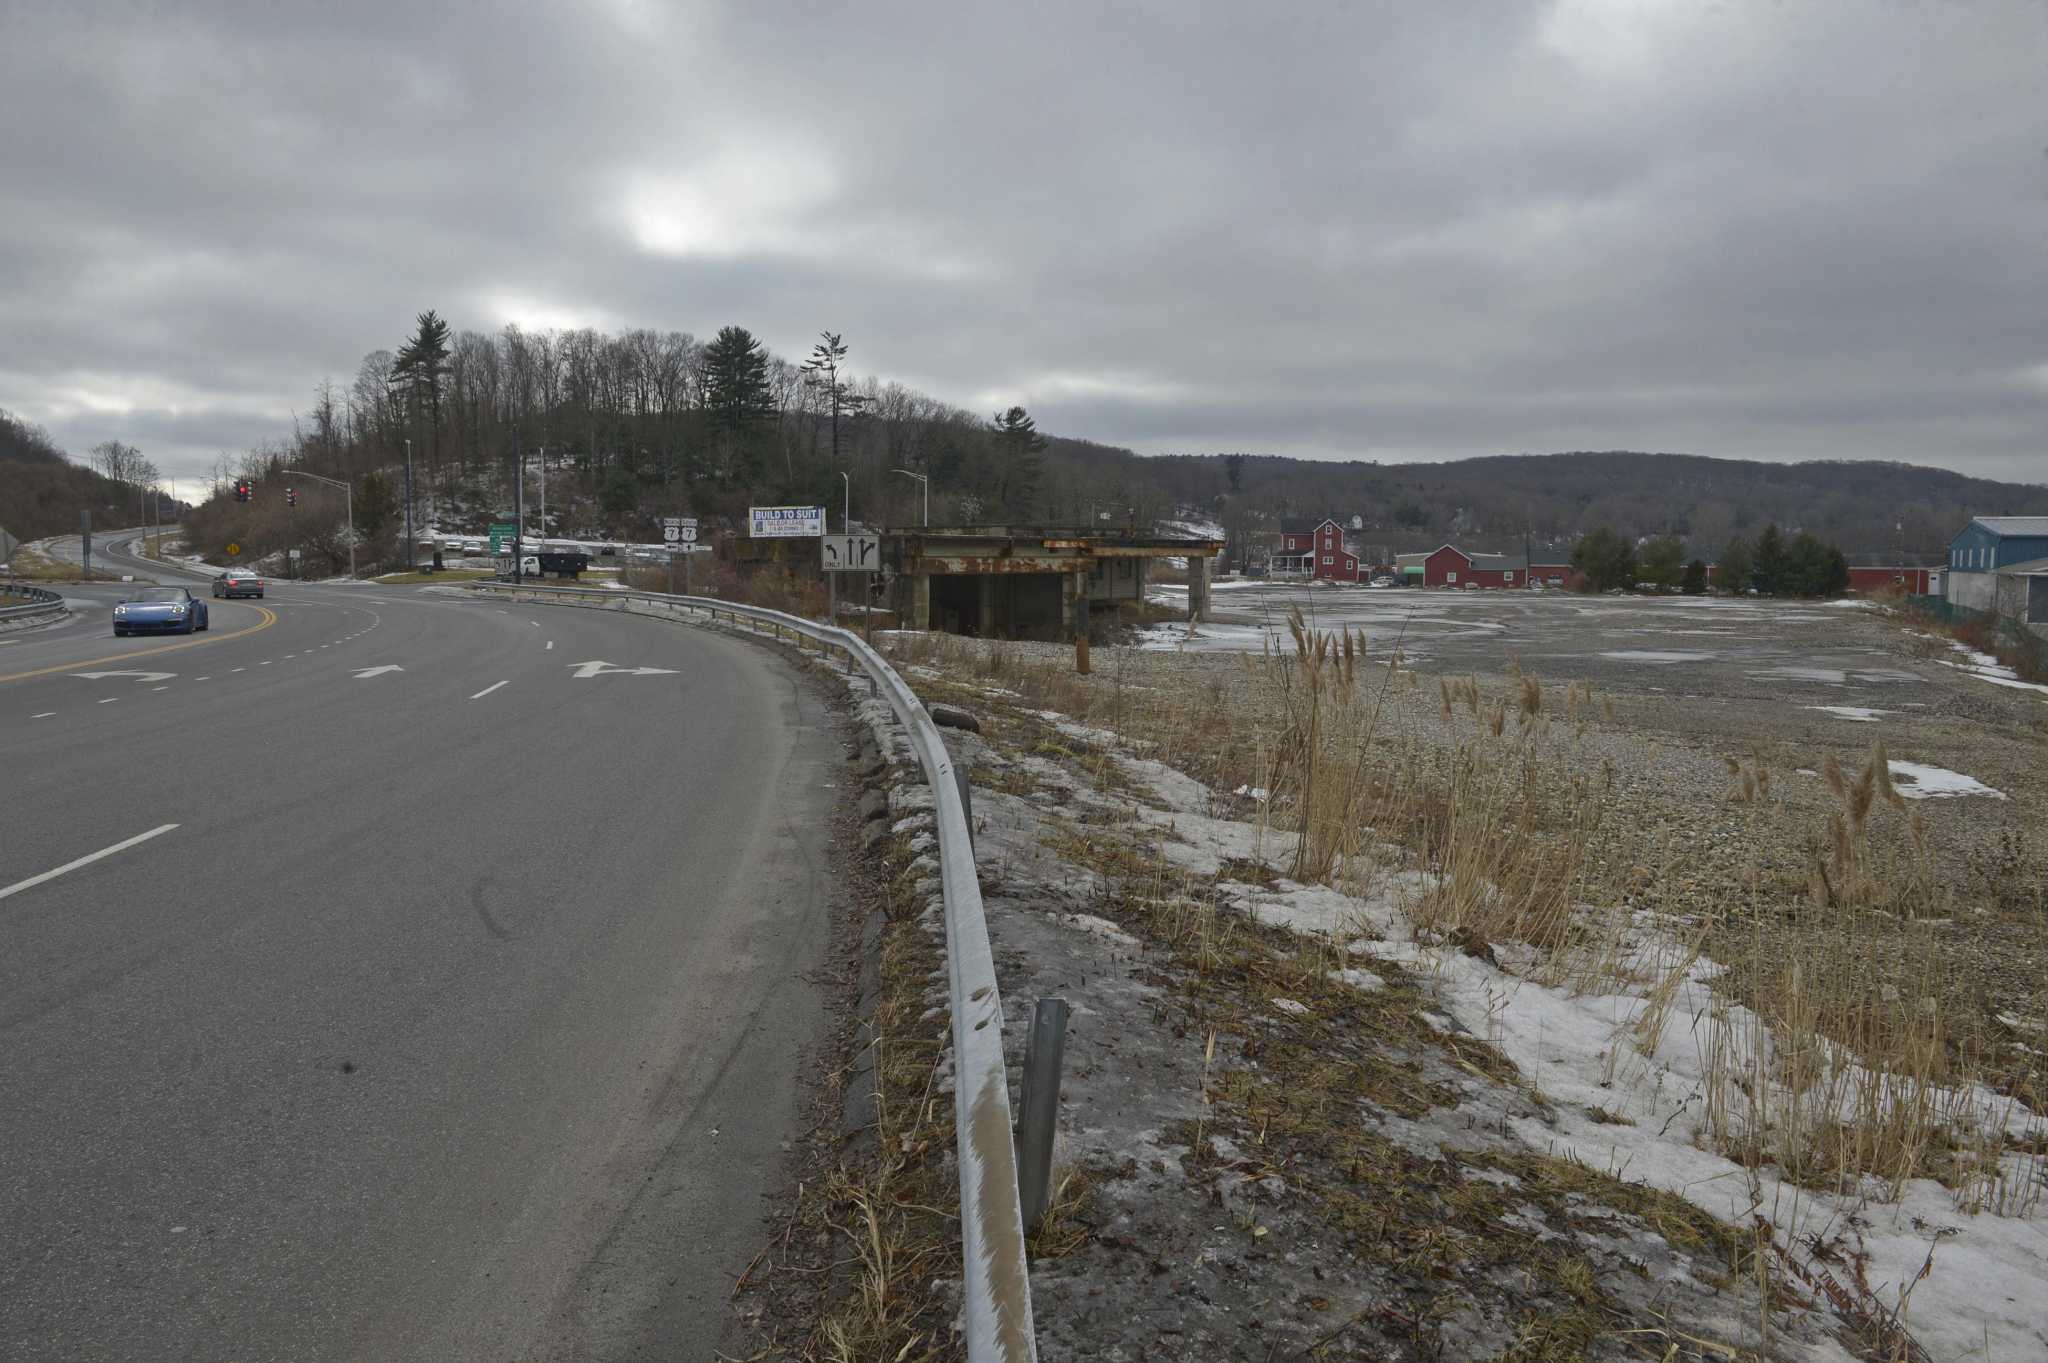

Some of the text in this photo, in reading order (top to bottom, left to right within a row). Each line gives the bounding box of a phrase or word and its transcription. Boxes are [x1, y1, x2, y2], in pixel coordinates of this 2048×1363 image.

[755, 509, 817, 520] BUILD TO SUIT
[669, 529, 675, 538] 7
[686, 529, 692, 538] 7
